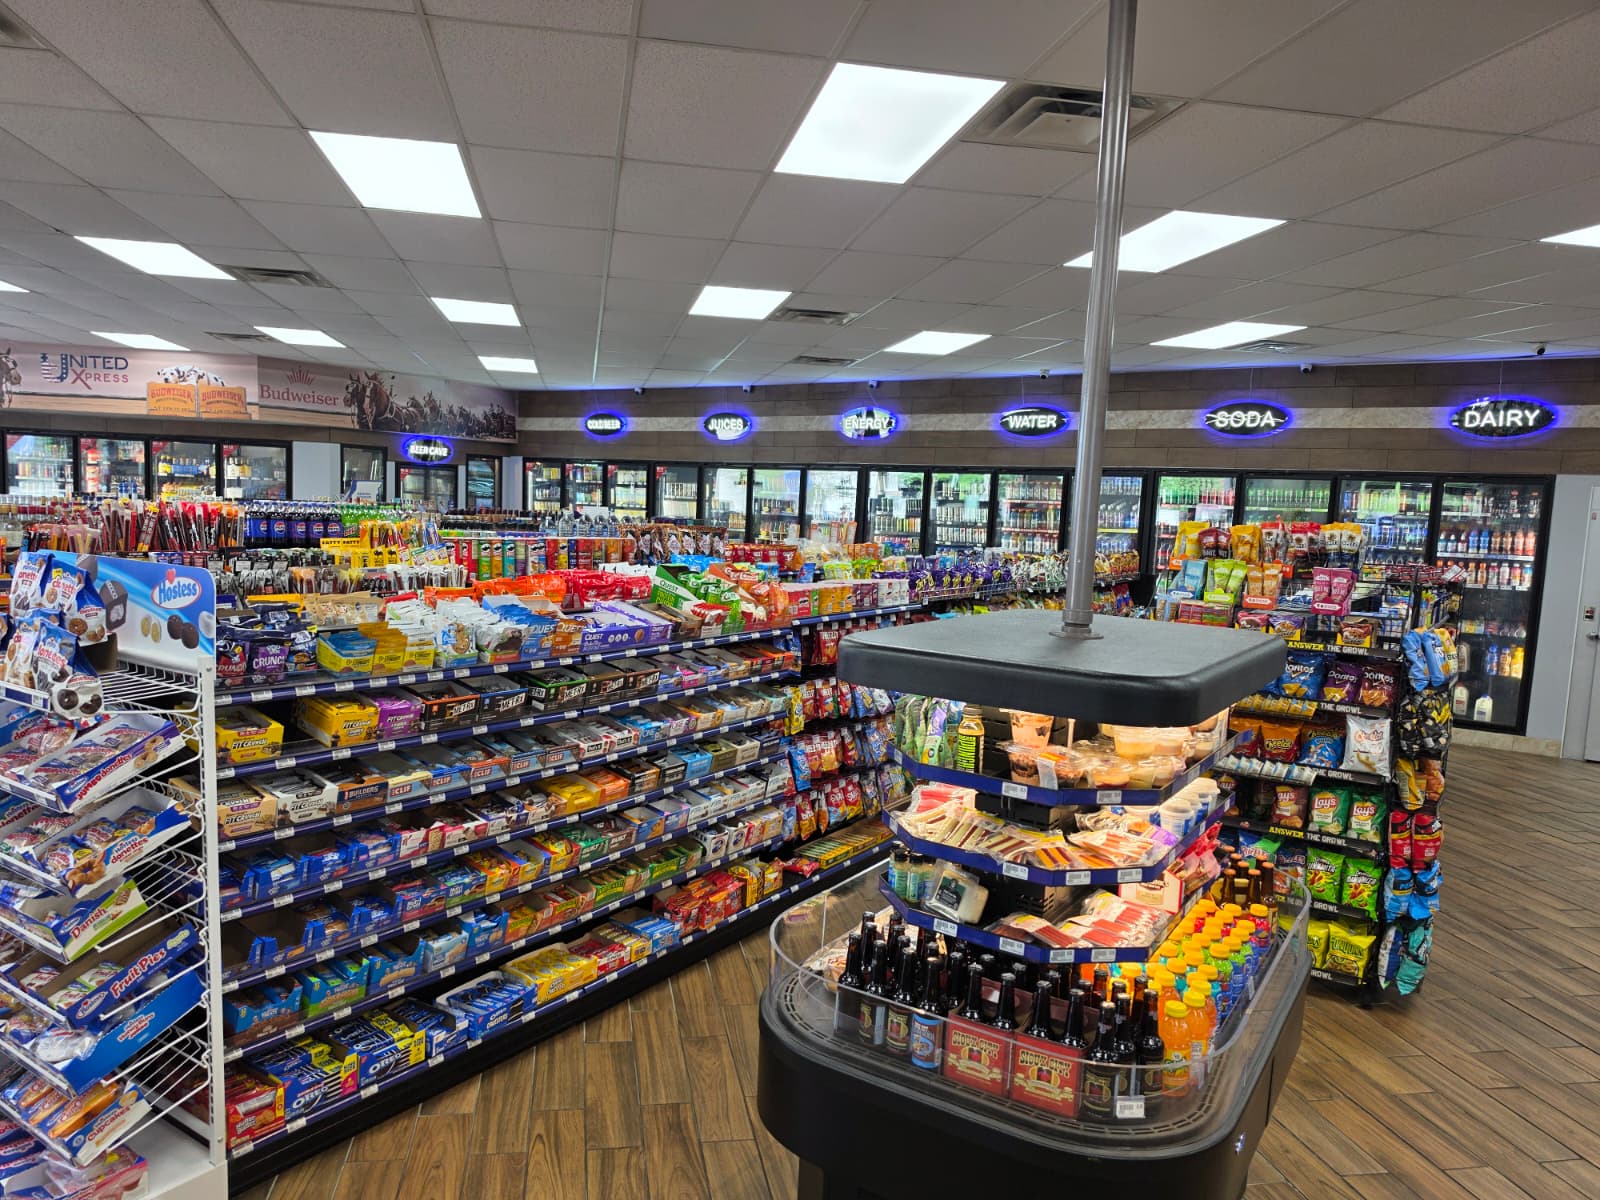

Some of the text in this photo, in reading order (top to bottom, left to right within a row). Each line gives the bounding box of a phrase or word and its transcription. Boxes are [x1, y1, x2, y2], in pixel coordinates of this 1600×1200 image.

[40, 352, 128, 383] UNITED
[70, 368, 129, 391] XPRESS
[260, 384, 339, 406] Budweiser
[708, 418, 743, 431] JUICES
[844, 416, 890, 430] ENERGY
[1007, 414, 1057, 429] WATER
[1214, 409, 1276, 428] SODA
[1464, 409, 1540, 428] DAIRY
[429, 446, 448, 457] CAVE
[159, 580, 198, 604] Hostess
[659, 579, 679, 592] QUEST
[1287, 641, 1324, 651] ANSWER
[1327, 644, 1341, 653] THE
[1342, 645, 1369, 656] GROWL
[1328, 671, 1358, 683] Doritos
[1335, 704, 1362, 714] GROWL
[1327, 770, 1353, 780] GROWL
[1269, 826, 1347, 846] ANSWER THE GROWL
[111, 837, 149, 865] donettes
[1314, 901, 1339, 912] GROWL
[70, 907, 107, 939] Danish
[110, 949, 166, 998] Fruit Pies
[952, 1031, 1000, 1060] SIOUX CITY
[369, 1052, 402, 1074] OREO
[1019, 1050, 1072, 1078] SIOUX CITY
[293, 1087, 329, 1108] OREO
[88, 1105, 131, 1142] Cupcakes
